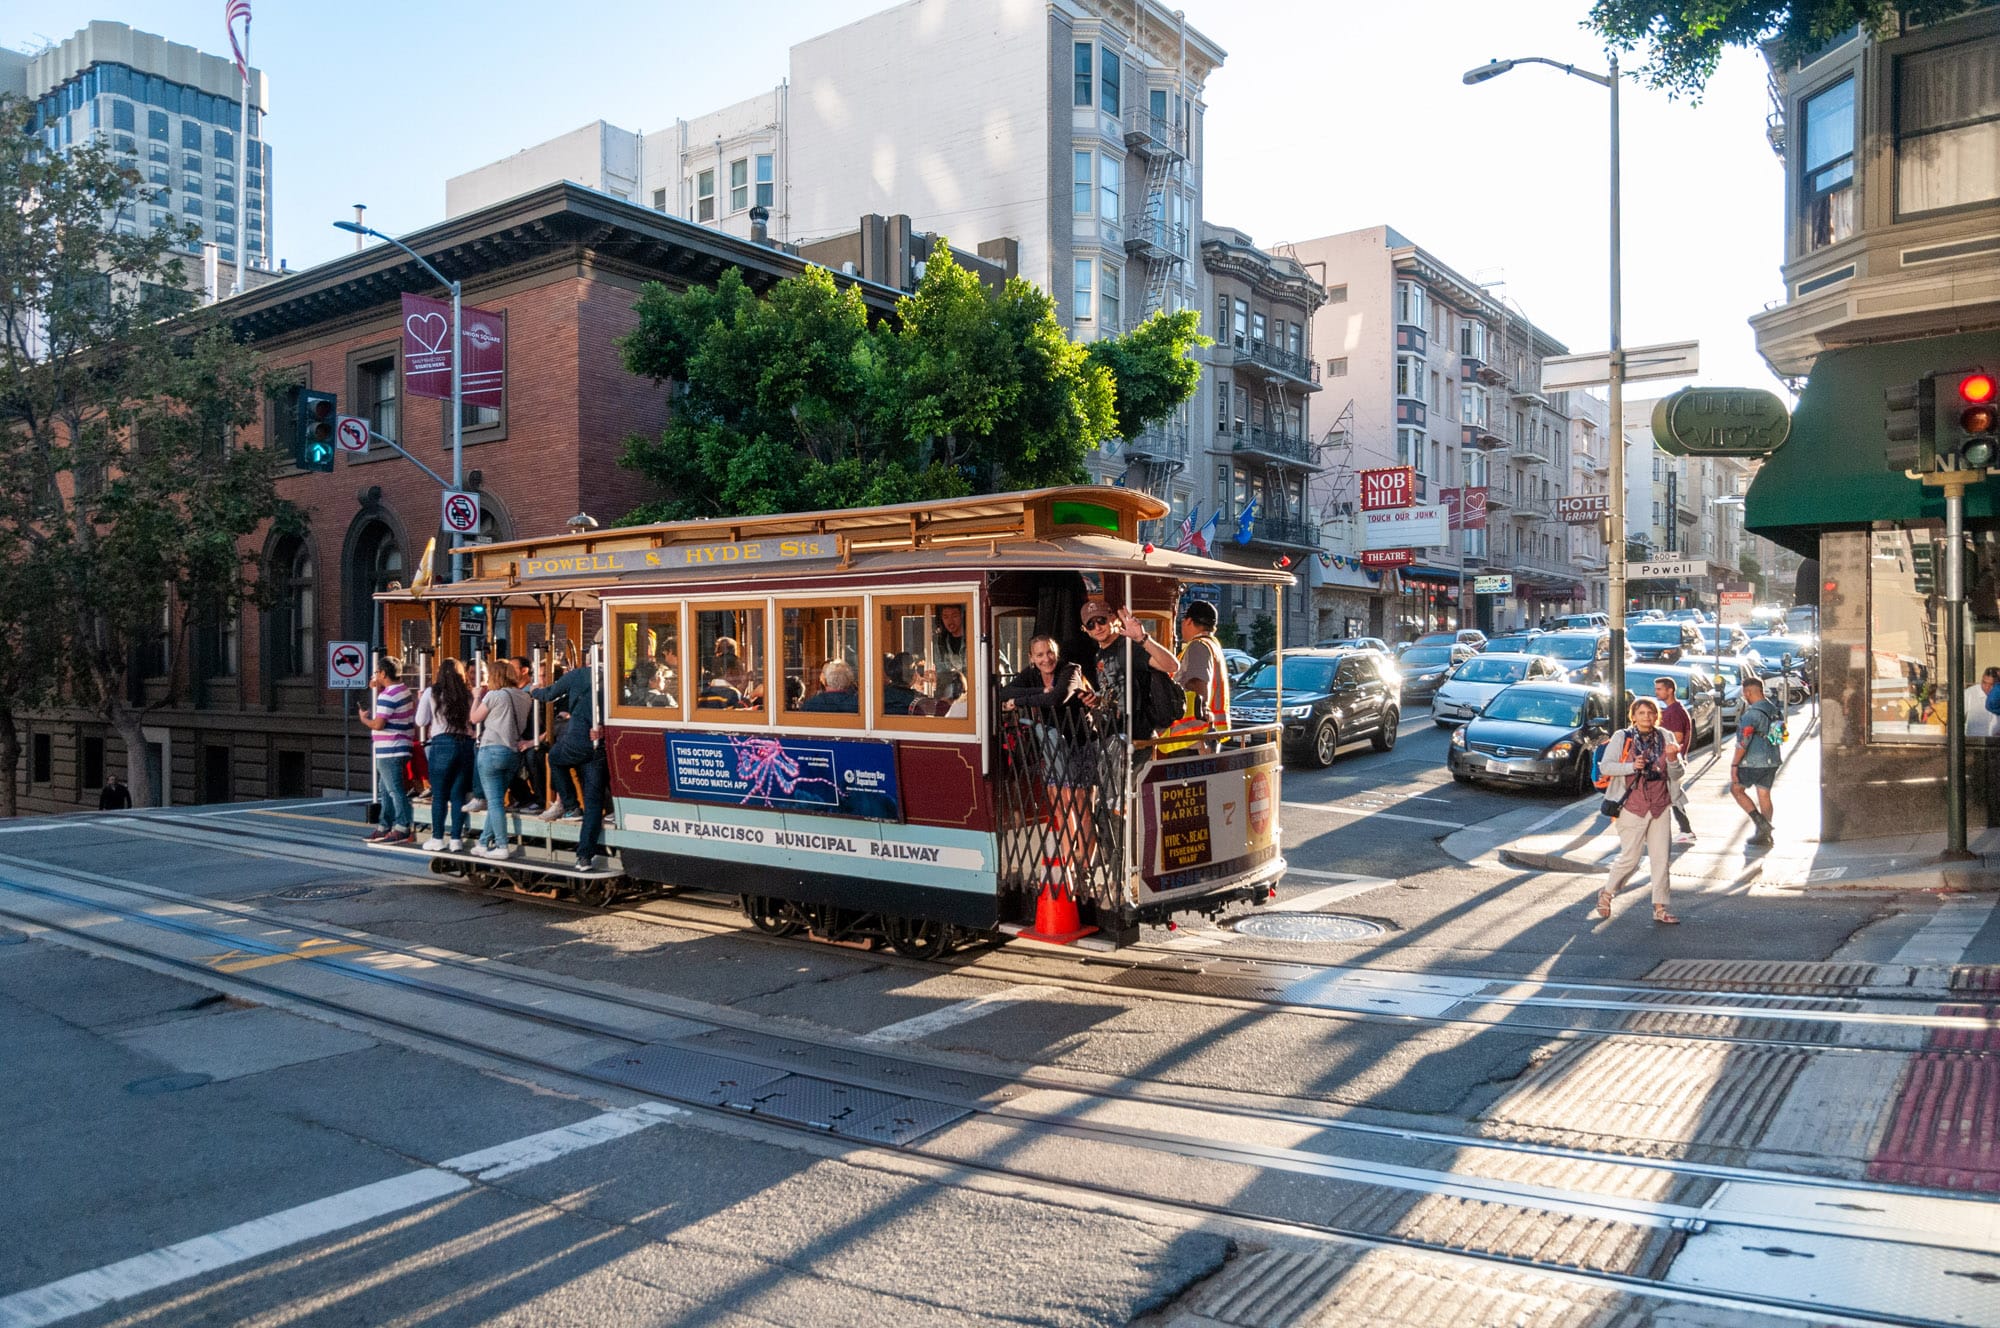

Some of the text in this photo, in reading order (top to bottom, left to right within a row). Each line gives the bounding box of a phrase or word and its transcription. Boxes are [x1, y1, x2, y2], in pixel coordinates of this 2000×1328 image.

[462, 330, 500, 343] UNION SQUARE
[1367, 472, 1406, 491] NOB
[1367, 489, 1406, 507] HILL
[1559, 496, 1609, 511] HOTEL
[1368, 510, 1437, 523] TOUCH OUR JUNK!
[1565, 510, 1601, 521] GRANT
[527, 540, 825, 574] POWELL & HYDE Sts.
[1367, 551, 1407, 562] THEATRE
[1642, 563, 1692, 575] Powell
[676, 747, 723, 758] THIS OCTOPUS
[630, 753, 645, 773] 7
[678, 757, 725, 768] WANTS YOU TO
[679, 767, 730, 778] DOWNLOAD OUR
[876, 771, 886, 781] Bay
[680, 777, 748, 790] SEAFOOD WATCH APP
[1162, 785, 1205, 801] POWELL
[1175, 797, 1196, 808] AND
[1162, 804, 1206, 821] MARKET
[1222, 802, 1236, 825] 7
[652, 818, 939, 862] SAN FRANCISCO MUNICIPAL RAILWAY
[1164, 833, 1180, 847] HYDE
[1189, 828, 1208, 843] BEACH
[1169, 843, 1206, 858] FISHERMANS
[1178, 853, 1199, 864] WHARF
